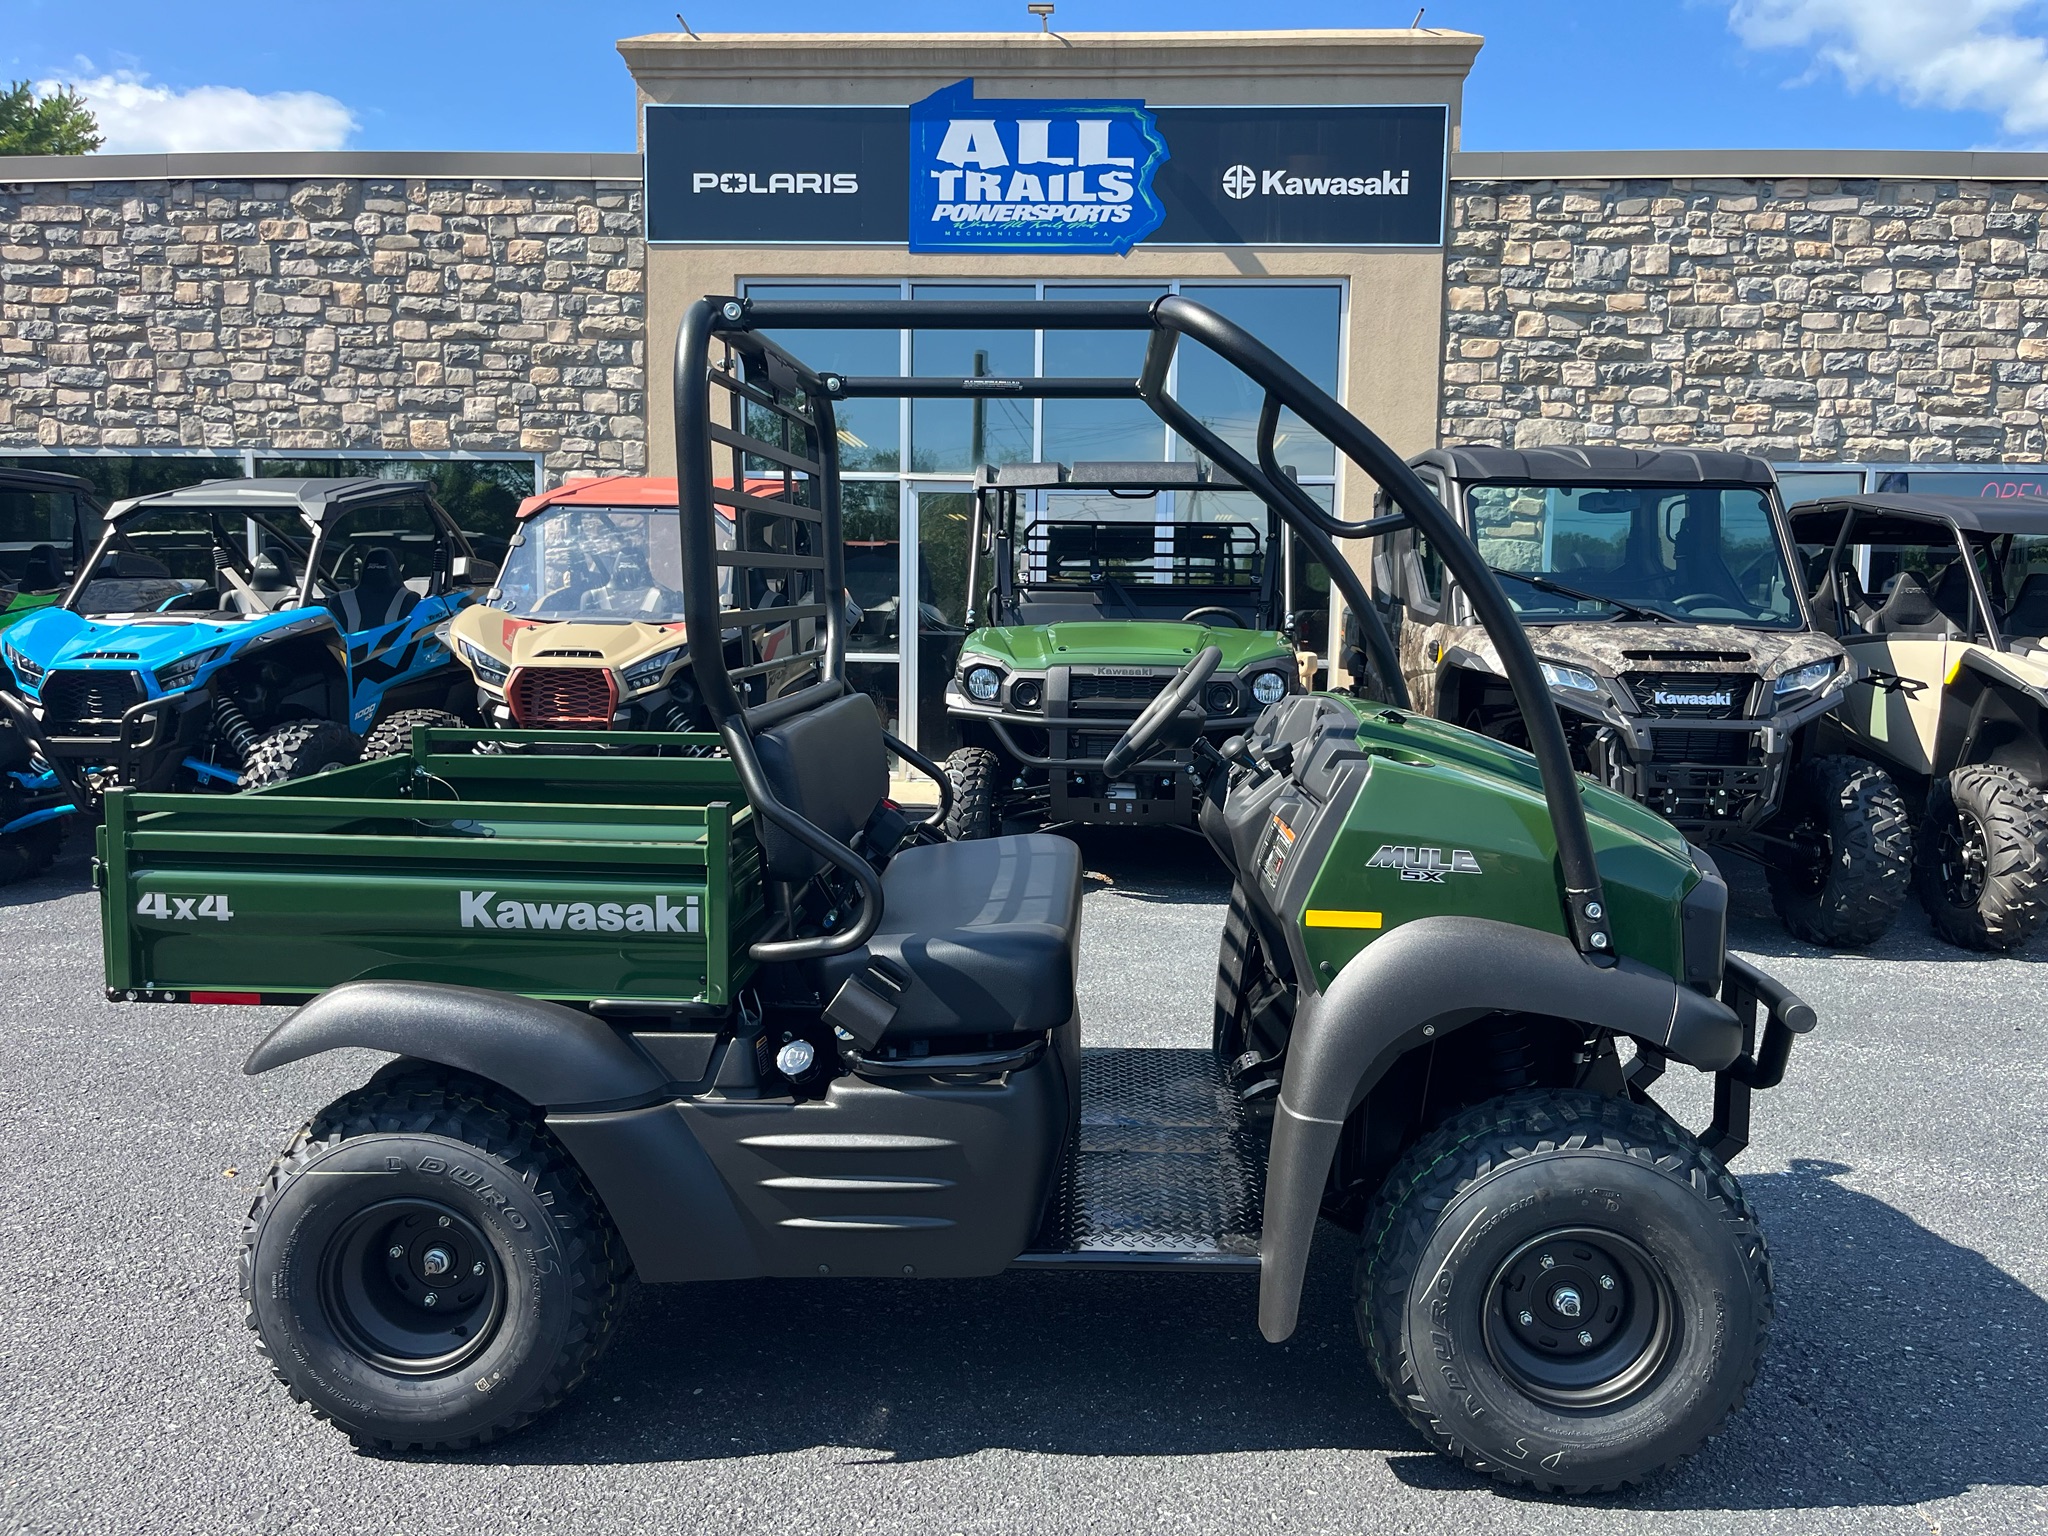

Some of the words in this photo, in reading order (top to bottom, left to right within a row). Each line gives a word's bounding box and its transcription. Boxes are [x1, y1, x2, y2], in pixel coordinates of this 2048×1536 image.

[936, 119, 1135, 169] ALL
[693, 173, 859, 194] POLARIS
[930, 169, 1134, 203] TRAILS
[1261, 170, 1410, 196] Kawasaki
[931, 204, 1133, 223] POWERSPORTS
[1097, 667, 1153, 676] Kawasaki
[1654, 691, 1731, 706] Kawasaki
[1364, 844, 1483, 875] MULE
[1400, 869, 1446, 883] SX
[136, 892, 235, 921] 4x4
[459, 890, 700, 934] Kawasaki
[416, 1155, 529, 1231] DURO
[1430, 1268, 1468, 1391] DURO
